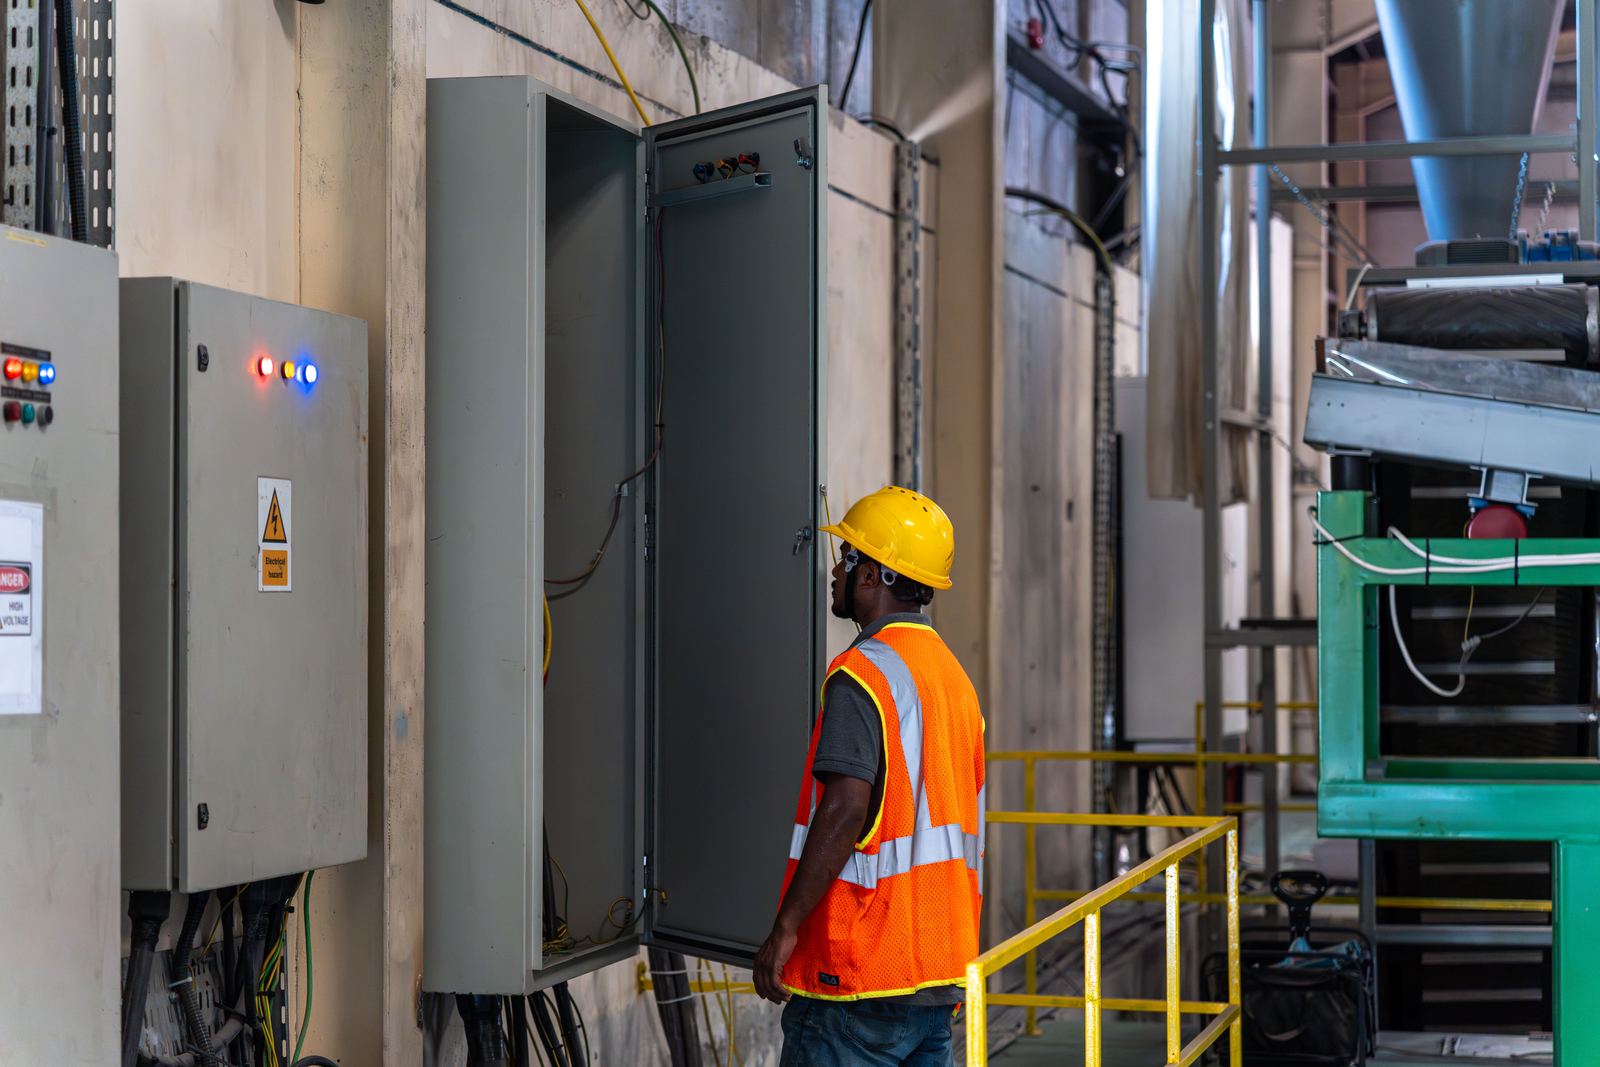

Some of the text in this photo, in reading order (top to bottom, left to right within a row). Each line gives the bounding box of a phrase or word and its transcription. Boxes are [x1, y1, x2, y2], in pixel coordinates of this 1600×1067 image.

[265, 557, 285, 565] Electrical
[268, 570, 283, 578] hazard
[0, 573, 24, 587] NGER
[8, 601, 23, 611] HIGH
[2, 615, 29, 626] VOLTAGE
